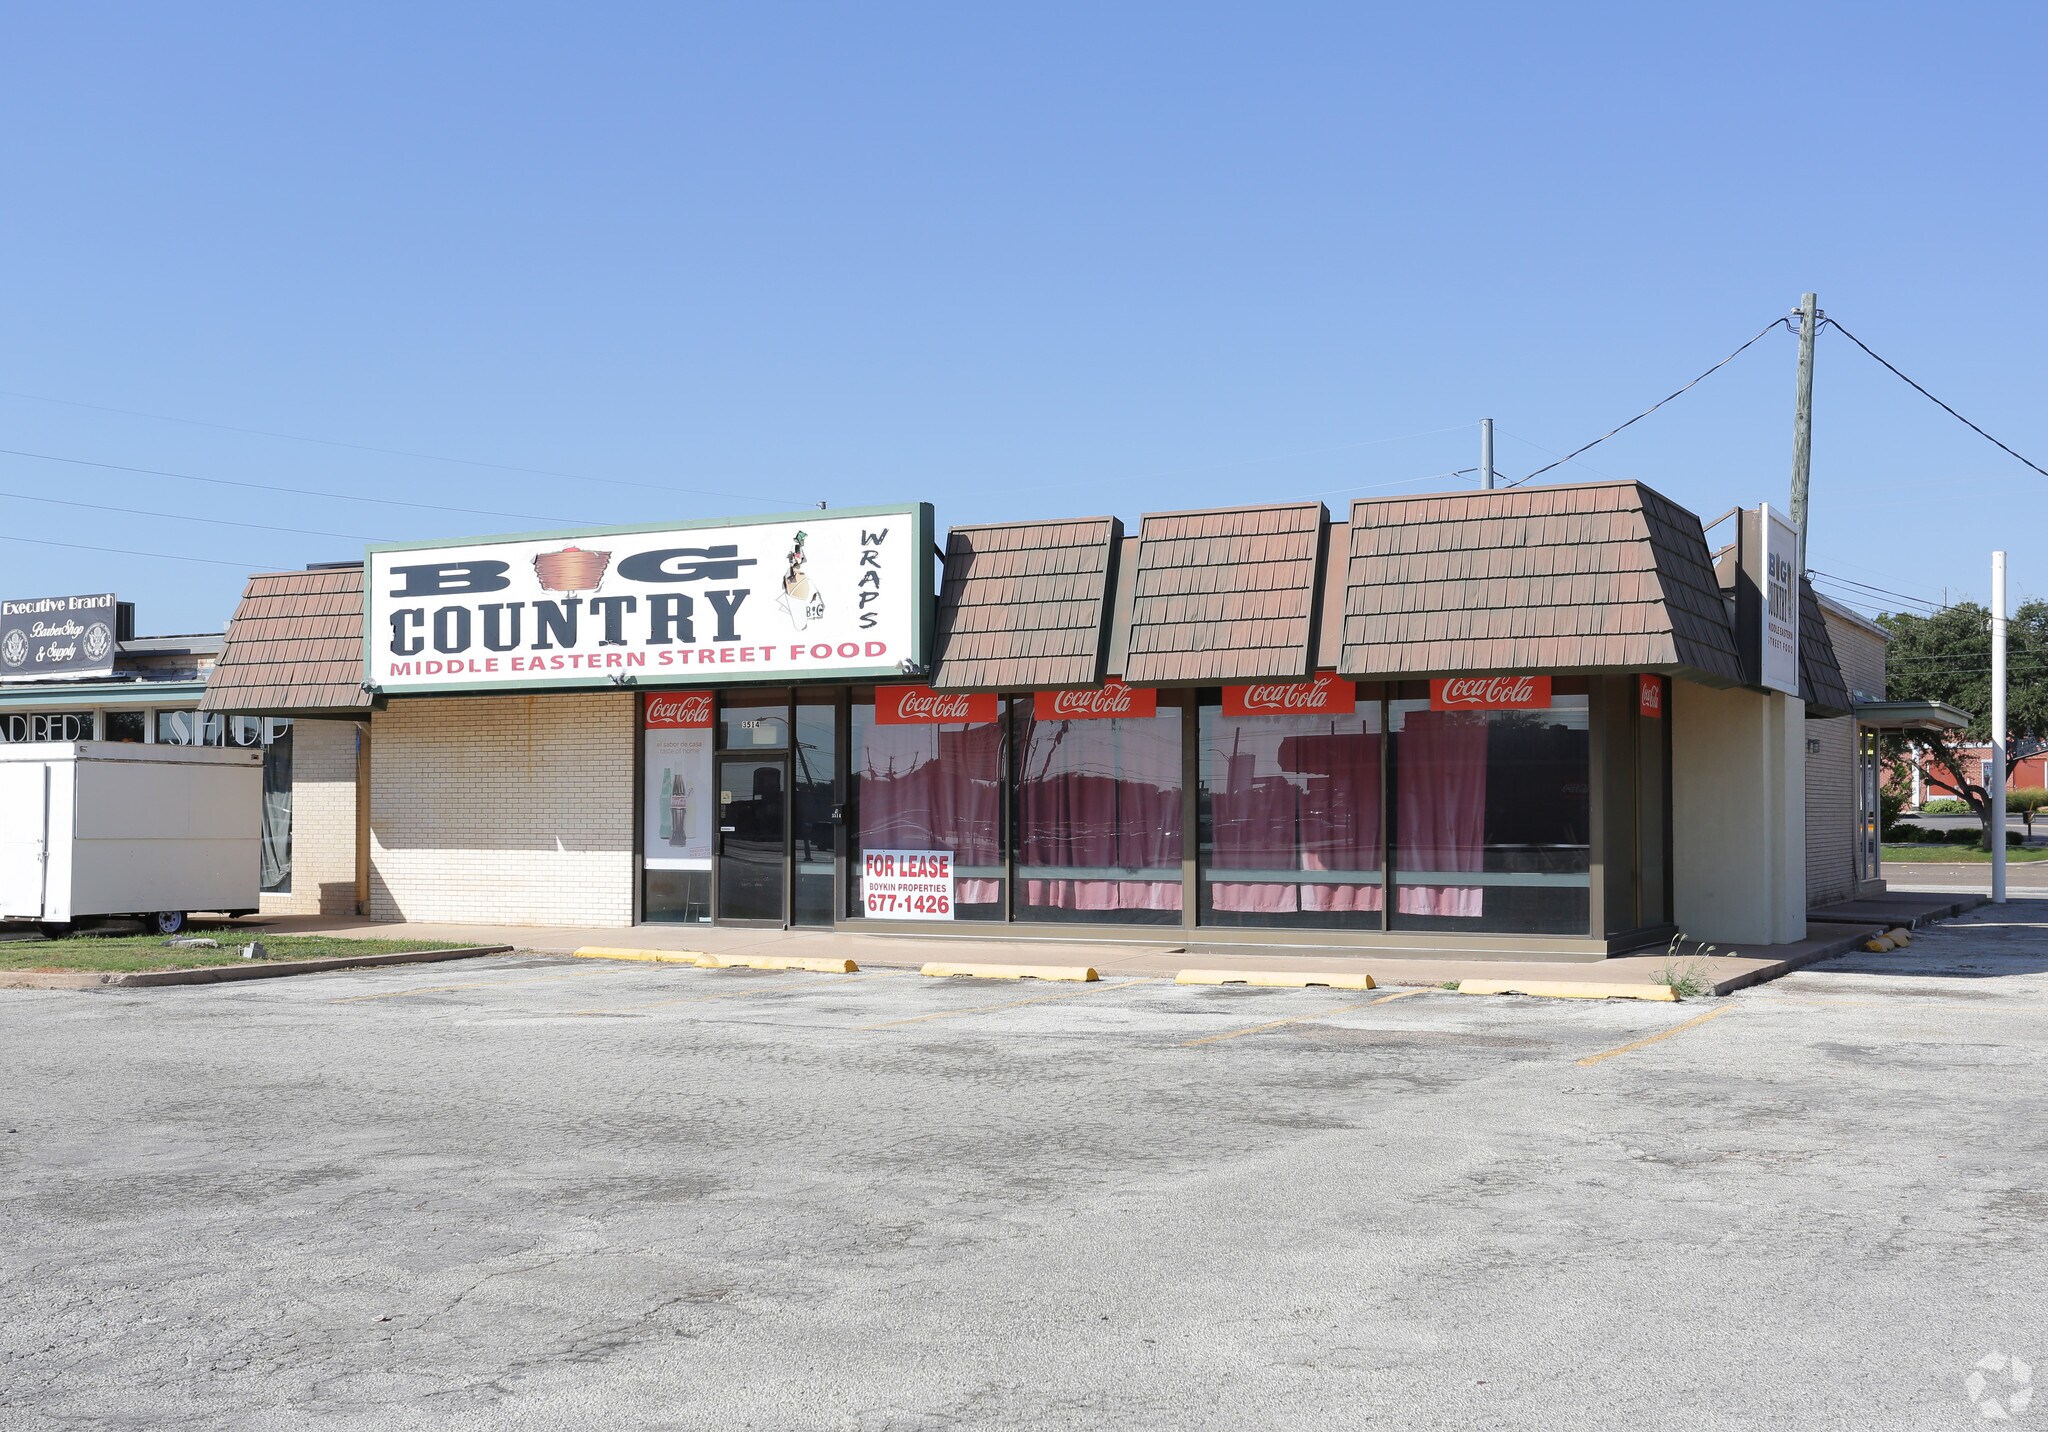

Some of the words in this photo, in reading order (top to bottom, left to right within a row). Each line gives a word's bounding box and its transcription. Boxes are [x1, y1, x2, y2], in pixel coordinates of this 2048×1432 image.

[858, 528, 889, 629] WRAPS
[2, 598, 66, 616] Executive
[68, 593, 114, 610] Branch
[389, 588, 751, 657] COUNTRY
[35, 645, 46, 662] &
[46, 640, 77, 662] Supply
[390, 658, 499, 677] MIDDLE
[511, 651, 646, 672] EASTERN
[658, 645, 777, 666] STREET
[790, 641, 888, 661] FOOD
[1054, 683, 1132, 714] Coca-Cola
[1243, 677, 1334, 709] Coca-Cola
[1441, 676, 1535, 704] Coca-Cola
[646, 696, 713, 723] Coca-Cola
[897, 691, 970, 718] Coca-Cola
[742, 720, 760, 729] 3514
[866, 854, 895, 877] FOR
[899, 855, 949, 878] LEASE
[869, 882, 896, 891] BOYKIN
[898, 883, 947, 892] PROPERTIES
